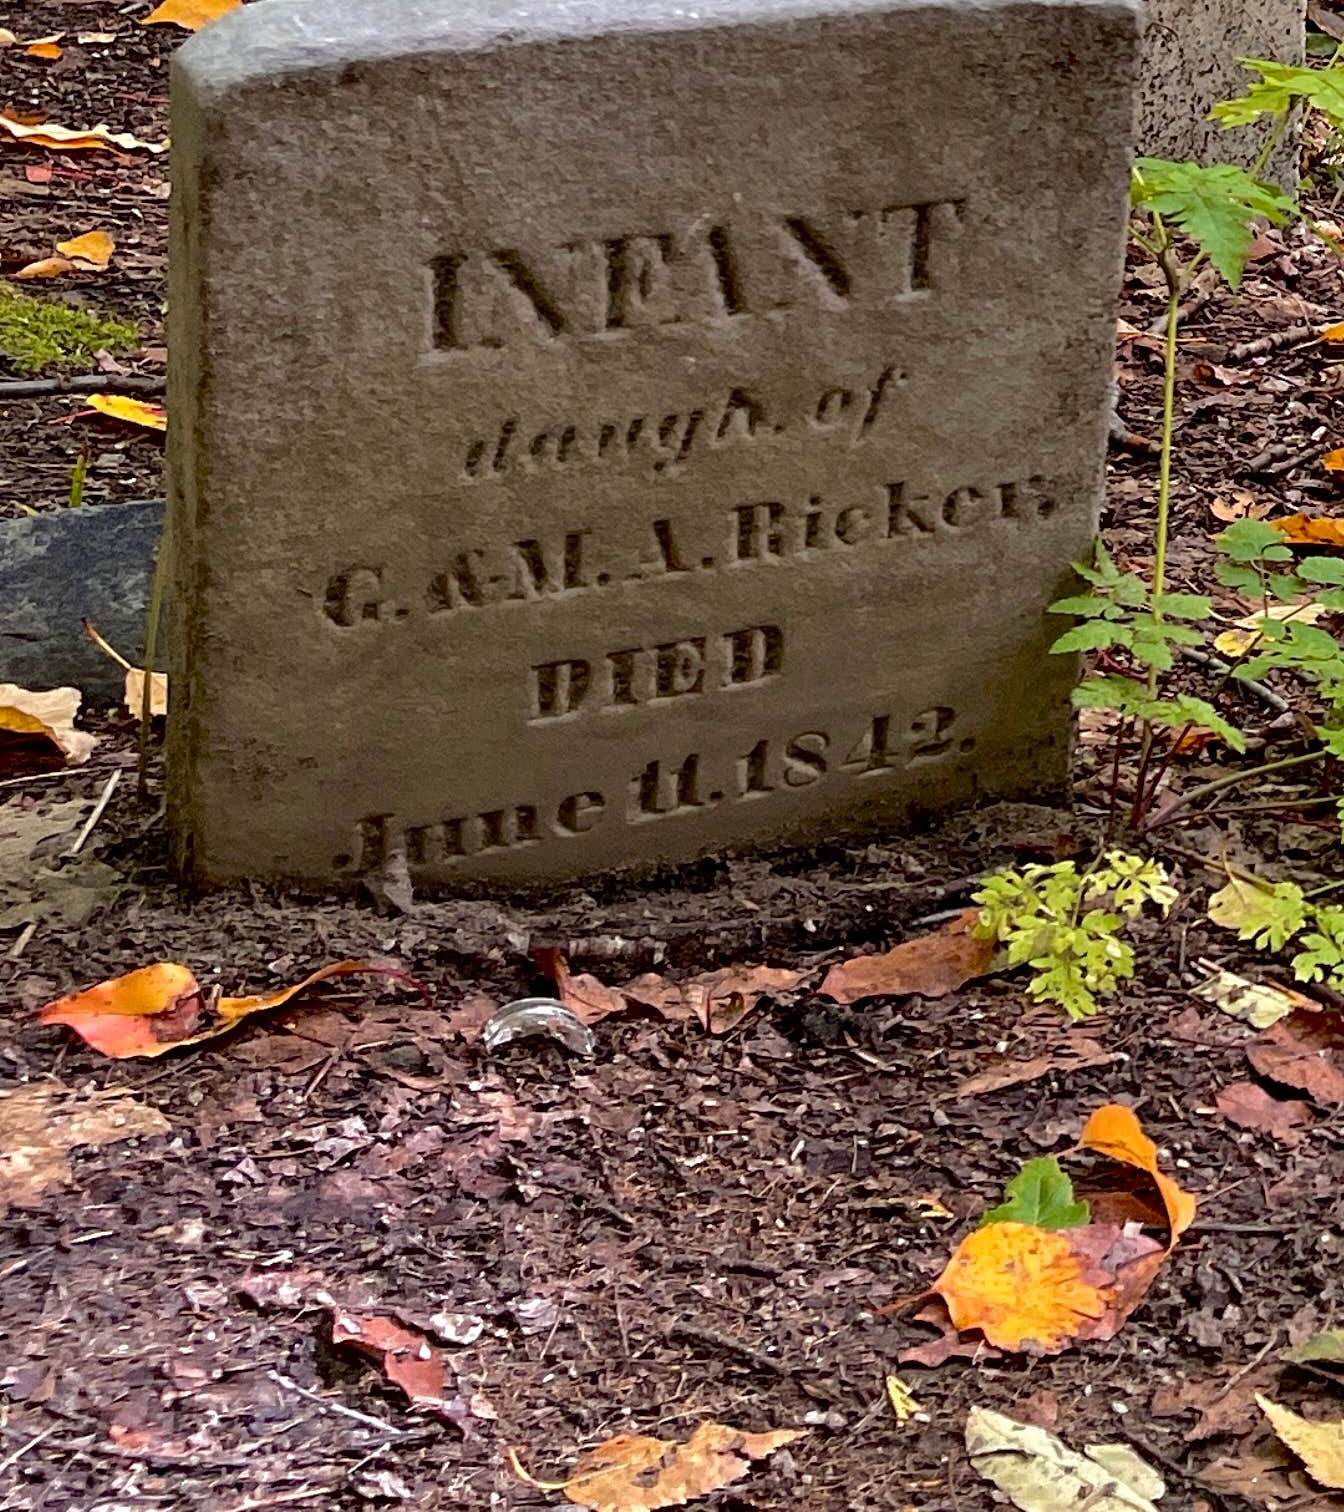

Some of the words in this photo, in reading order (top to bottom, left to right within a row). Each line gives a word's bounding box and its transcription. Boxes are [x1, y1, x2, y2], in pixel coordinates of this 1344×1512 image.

[419, 199, 969, 360] INFANT
[812, 365, 908, 443] of
[528, 625, 786, 725] DIED
[332, 792, 606, 871] June
[737, 706, 976, 800] 1842.
